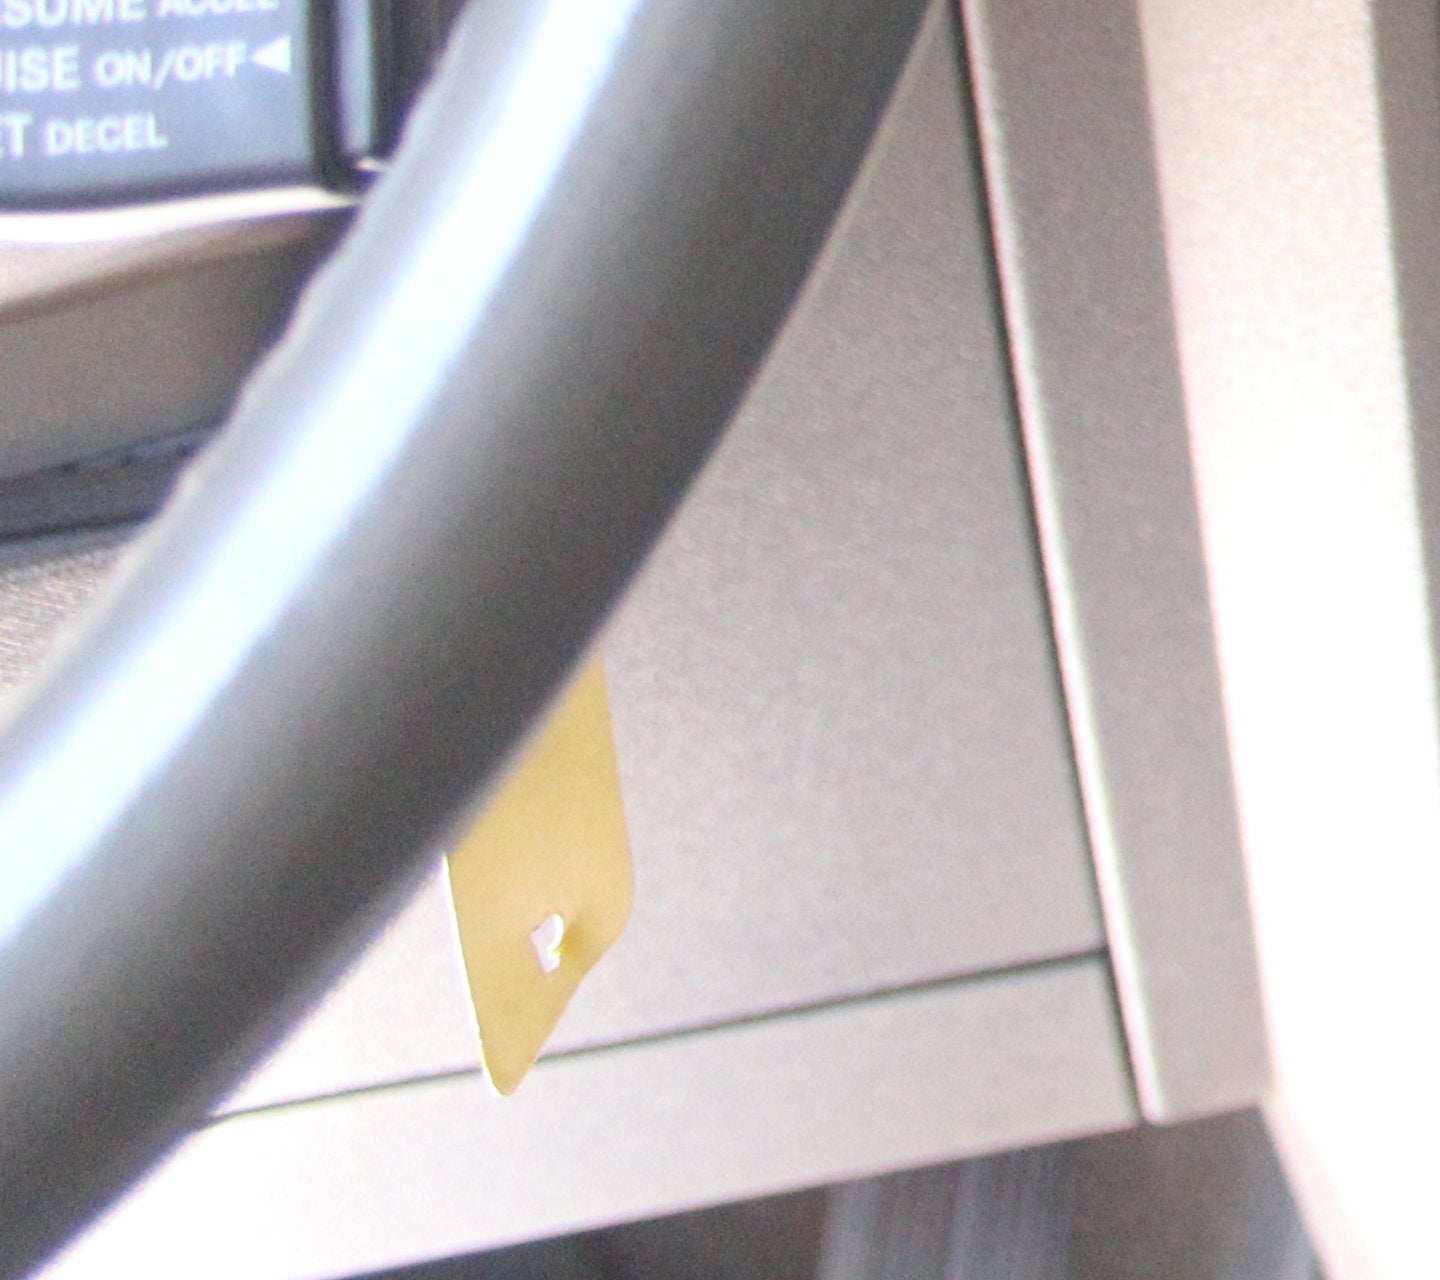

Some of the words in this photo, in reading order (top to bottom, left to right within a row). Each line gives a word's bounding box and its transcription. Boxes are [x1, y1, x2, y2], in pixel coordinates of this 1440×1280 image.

[0, 44, 82, 93] ISE
[96, 41, 246, 91] ON/OFF
[47, 111, 169, 156] DECEL
